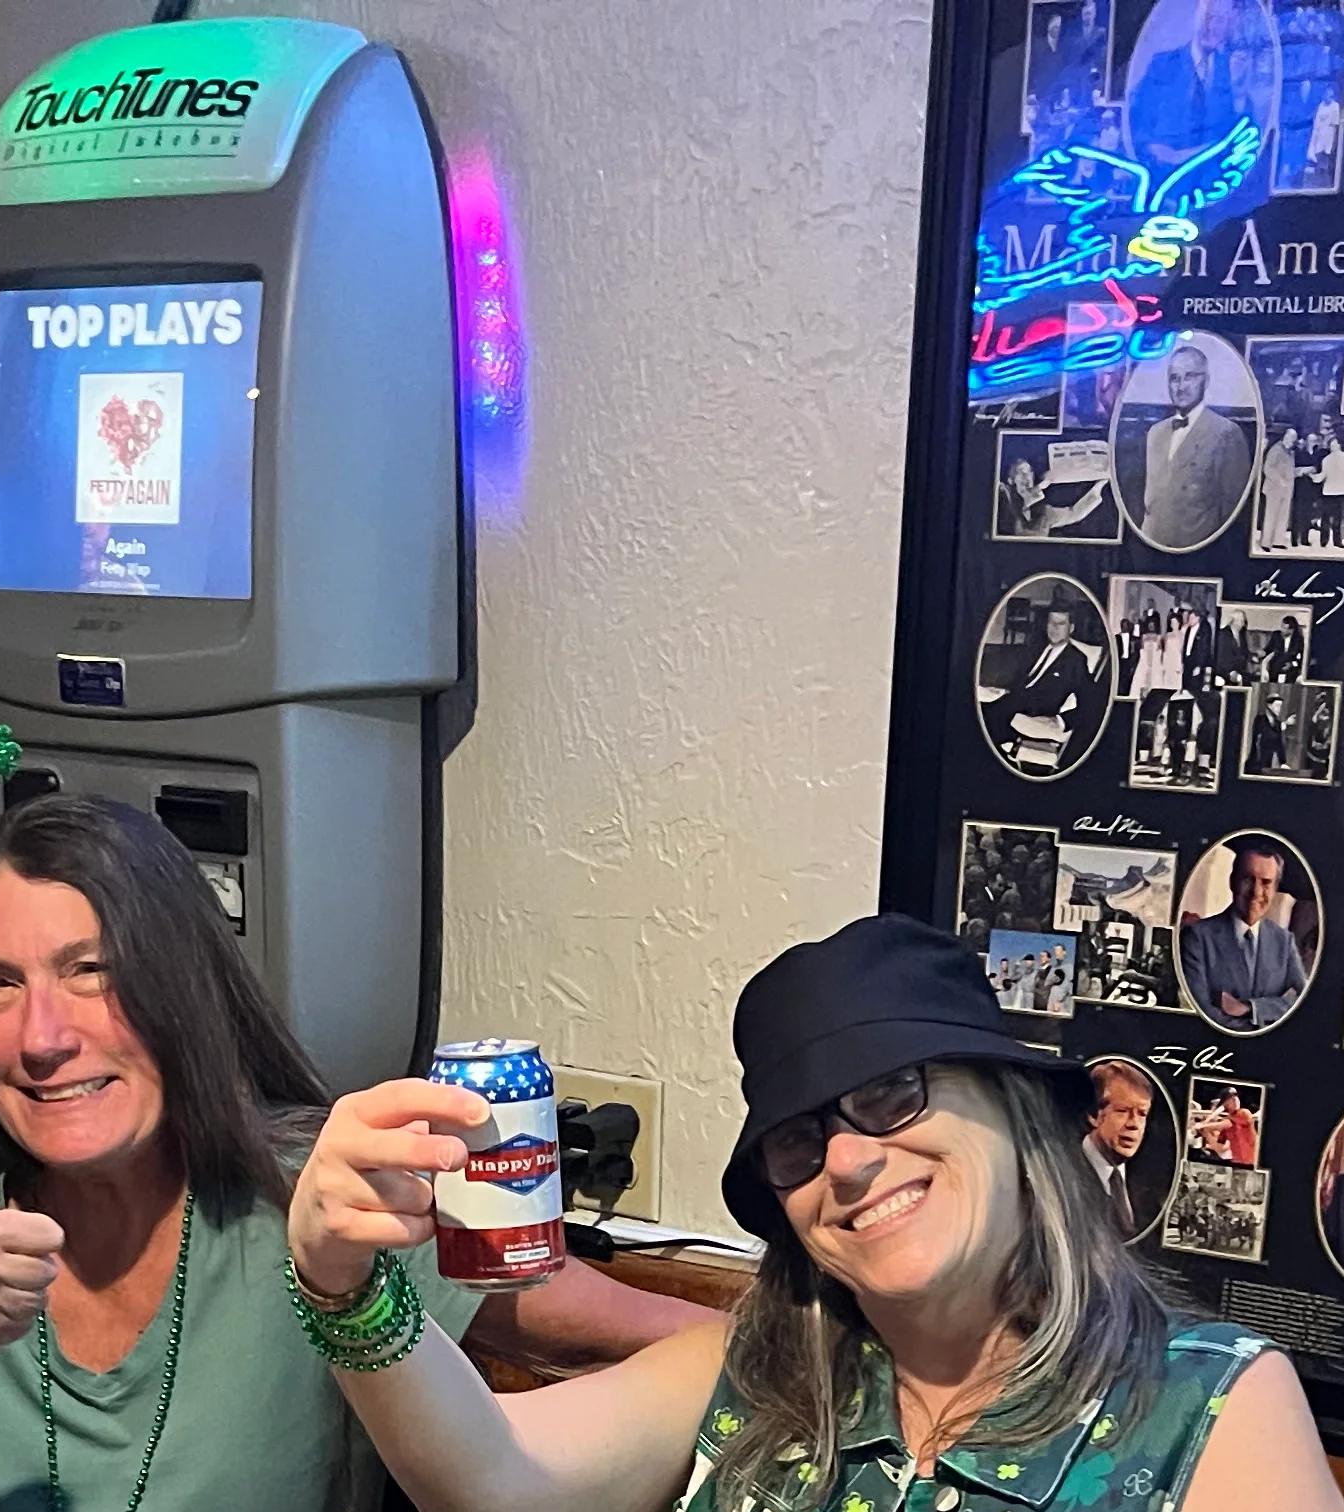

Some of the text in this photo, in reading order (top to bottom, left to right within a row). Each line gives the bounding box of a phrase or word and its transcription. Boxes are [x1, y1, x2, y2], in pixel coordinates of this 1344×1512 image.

[14, 68, 259, 132] TouchTunes
[1183, 296, 1305, 315] PRESIDENTIAL
[27, 299, 243, 349] TOP PLAYS
[126, 480, 171, 505] AGAIN
[105, 537, 146, 559] Again
[470, 1157, 533, 1174] Happy
